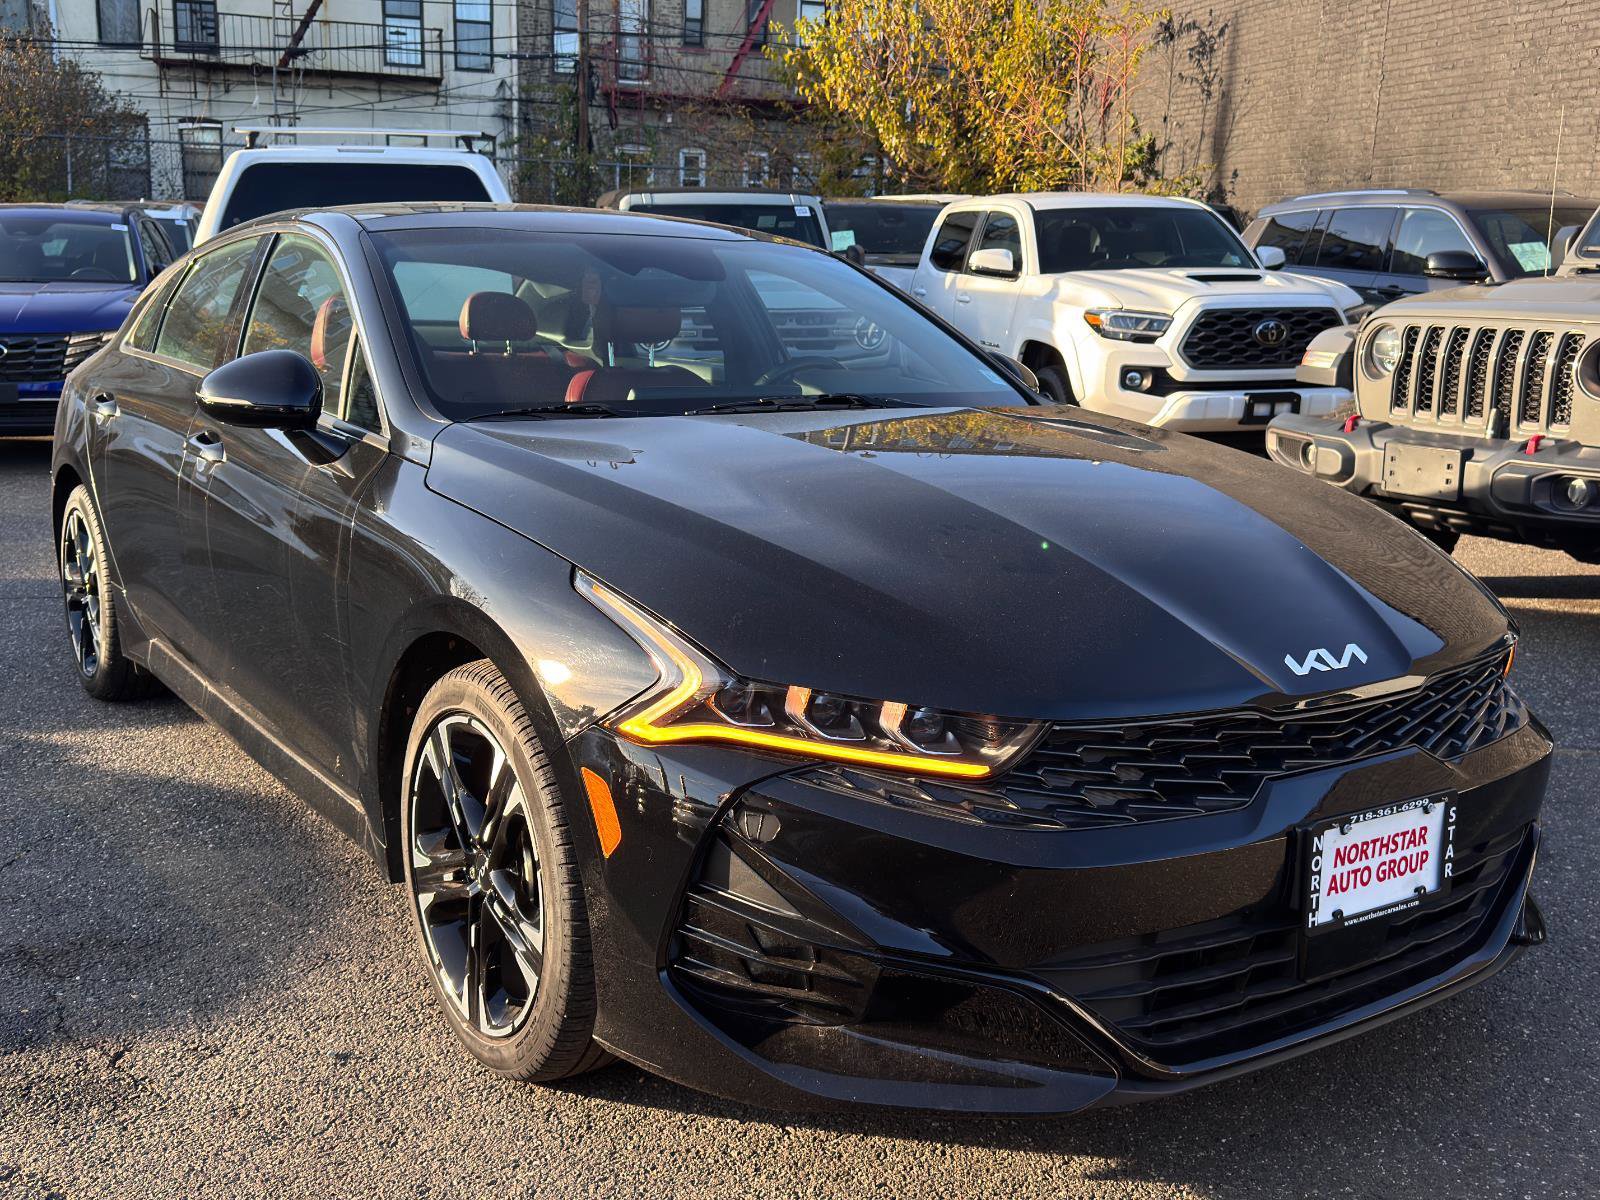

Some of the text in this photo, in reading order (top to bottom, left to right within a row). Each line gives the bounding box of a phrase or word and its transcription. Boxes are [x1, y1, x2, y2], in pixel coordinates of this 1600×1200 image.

[1284, 643, 1368, 675] KIA
[1350, 798, 1429, 824] 718-361-6299
[1334, 826, 1429, 868] NORTHSTAR
[1445, 806, 1457, 878] STAR
[1308, 835, 1324, 928] NORTH
[1327, 850, 1429, 896] AUTO GROUP
